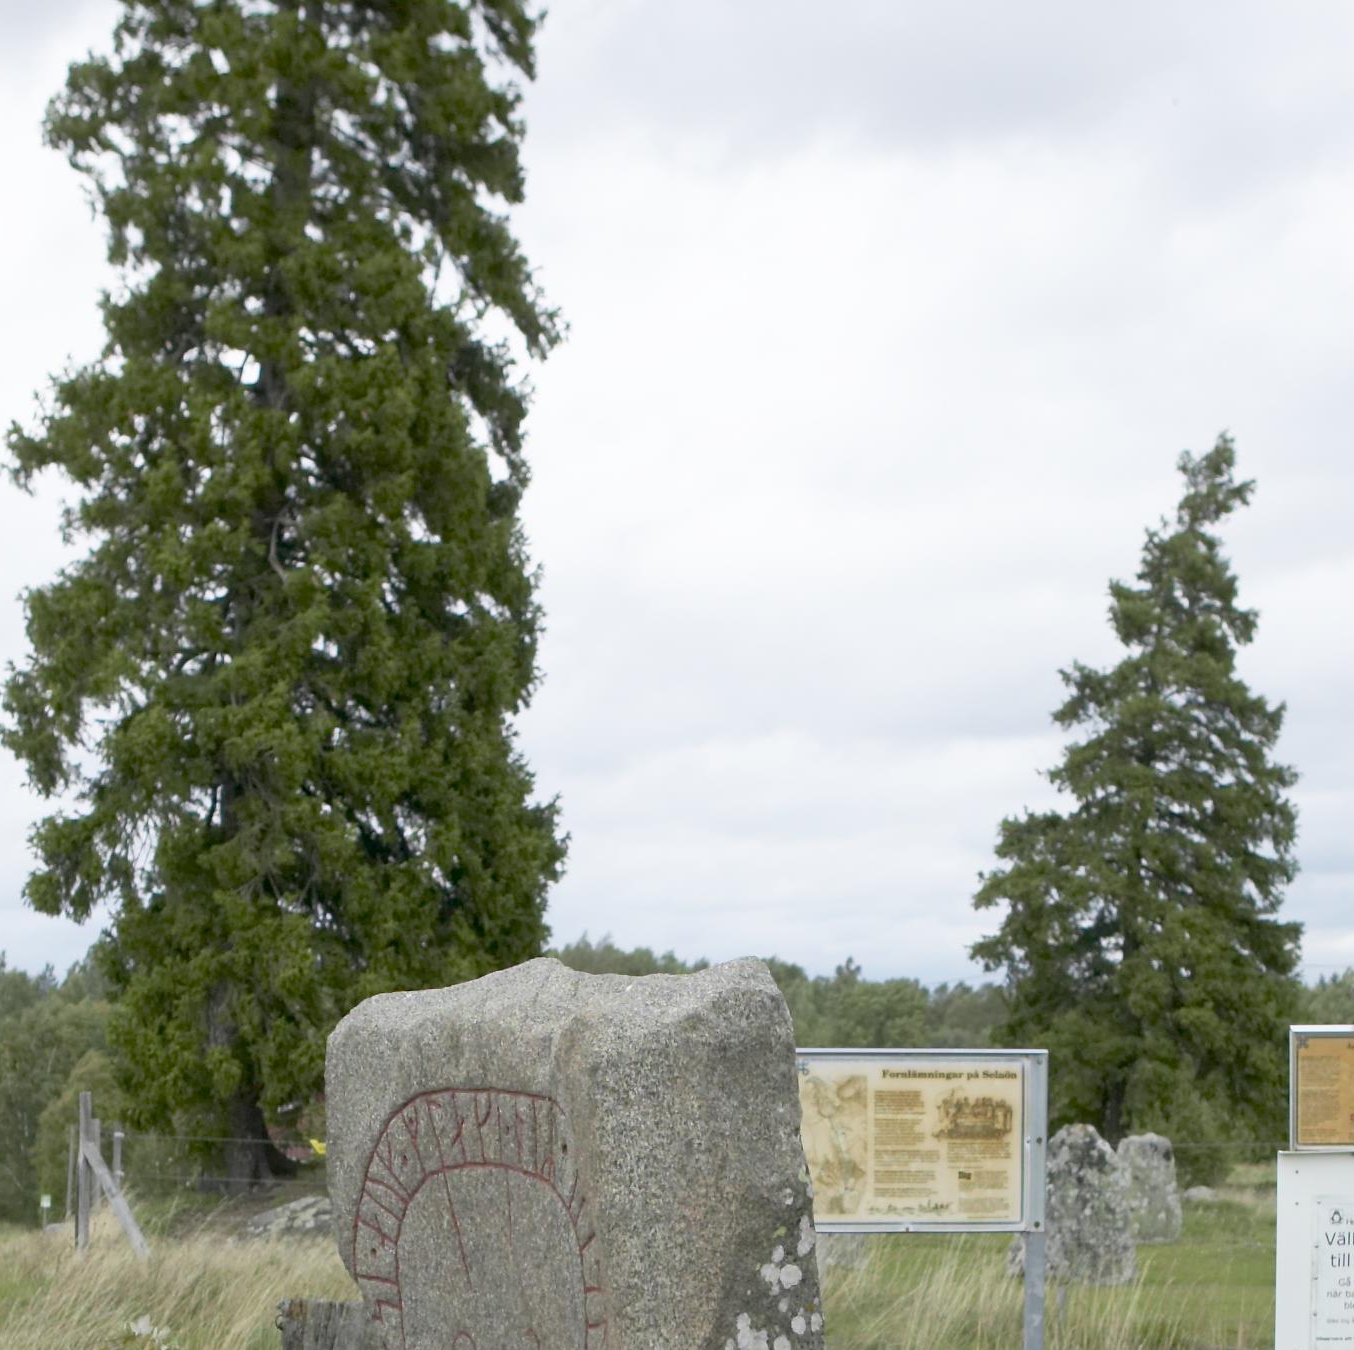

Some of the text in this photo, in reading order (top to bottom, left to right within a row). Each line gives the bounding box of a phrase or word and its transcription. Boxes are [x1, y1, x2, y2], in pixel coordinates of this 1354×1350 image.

[882, 1069, 1017, 1081] Fornlämningar på Selaön
[1331, 1252, 1350, 1267] till
[1338, 1276, 1351, 1287] Gå
[1326, 1290, 1343, 1298] när
